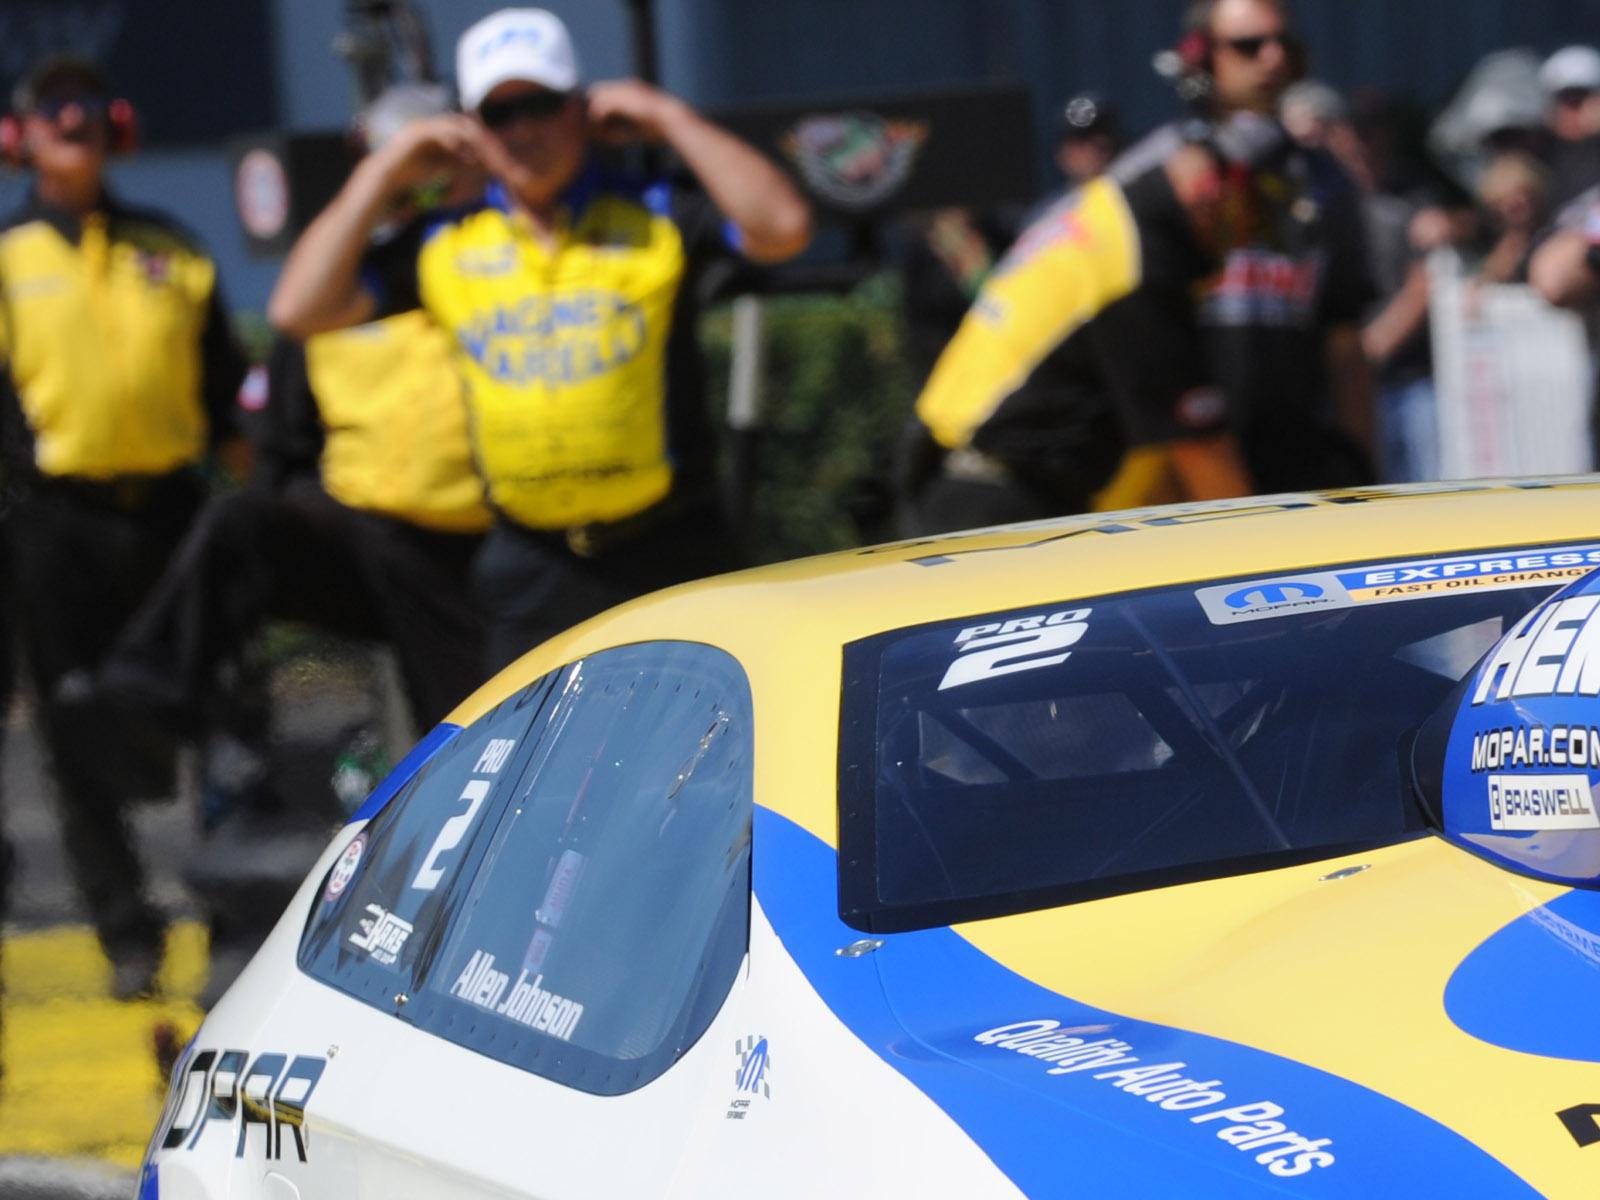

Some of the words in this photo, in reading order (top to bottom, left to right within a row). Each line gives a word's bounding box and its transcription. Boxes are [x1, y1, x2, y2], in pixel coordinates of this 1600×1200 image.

[1374, 582, 1436, 597] FAST
[1446, 578, 1479, 590] OIL
[953, 607, 1093, 643] PRO
[1231, 598, 1328, 616] MOPAR
[937, 621, 1089, 691] 2
[472, 739, 516, 773] PRO
[1504, 789, 1590, 816] BRASWELL
[412, 780, 490, 889] 2
[450, 949, 509, 1016] Allen
[497, 968, 584, 1041] Johnson
[974, 1019, 1140, 1075] Quality
[1093, 1062, 1227, 1111] Auto
[1189, 1100, 1336, 1177] Parts
